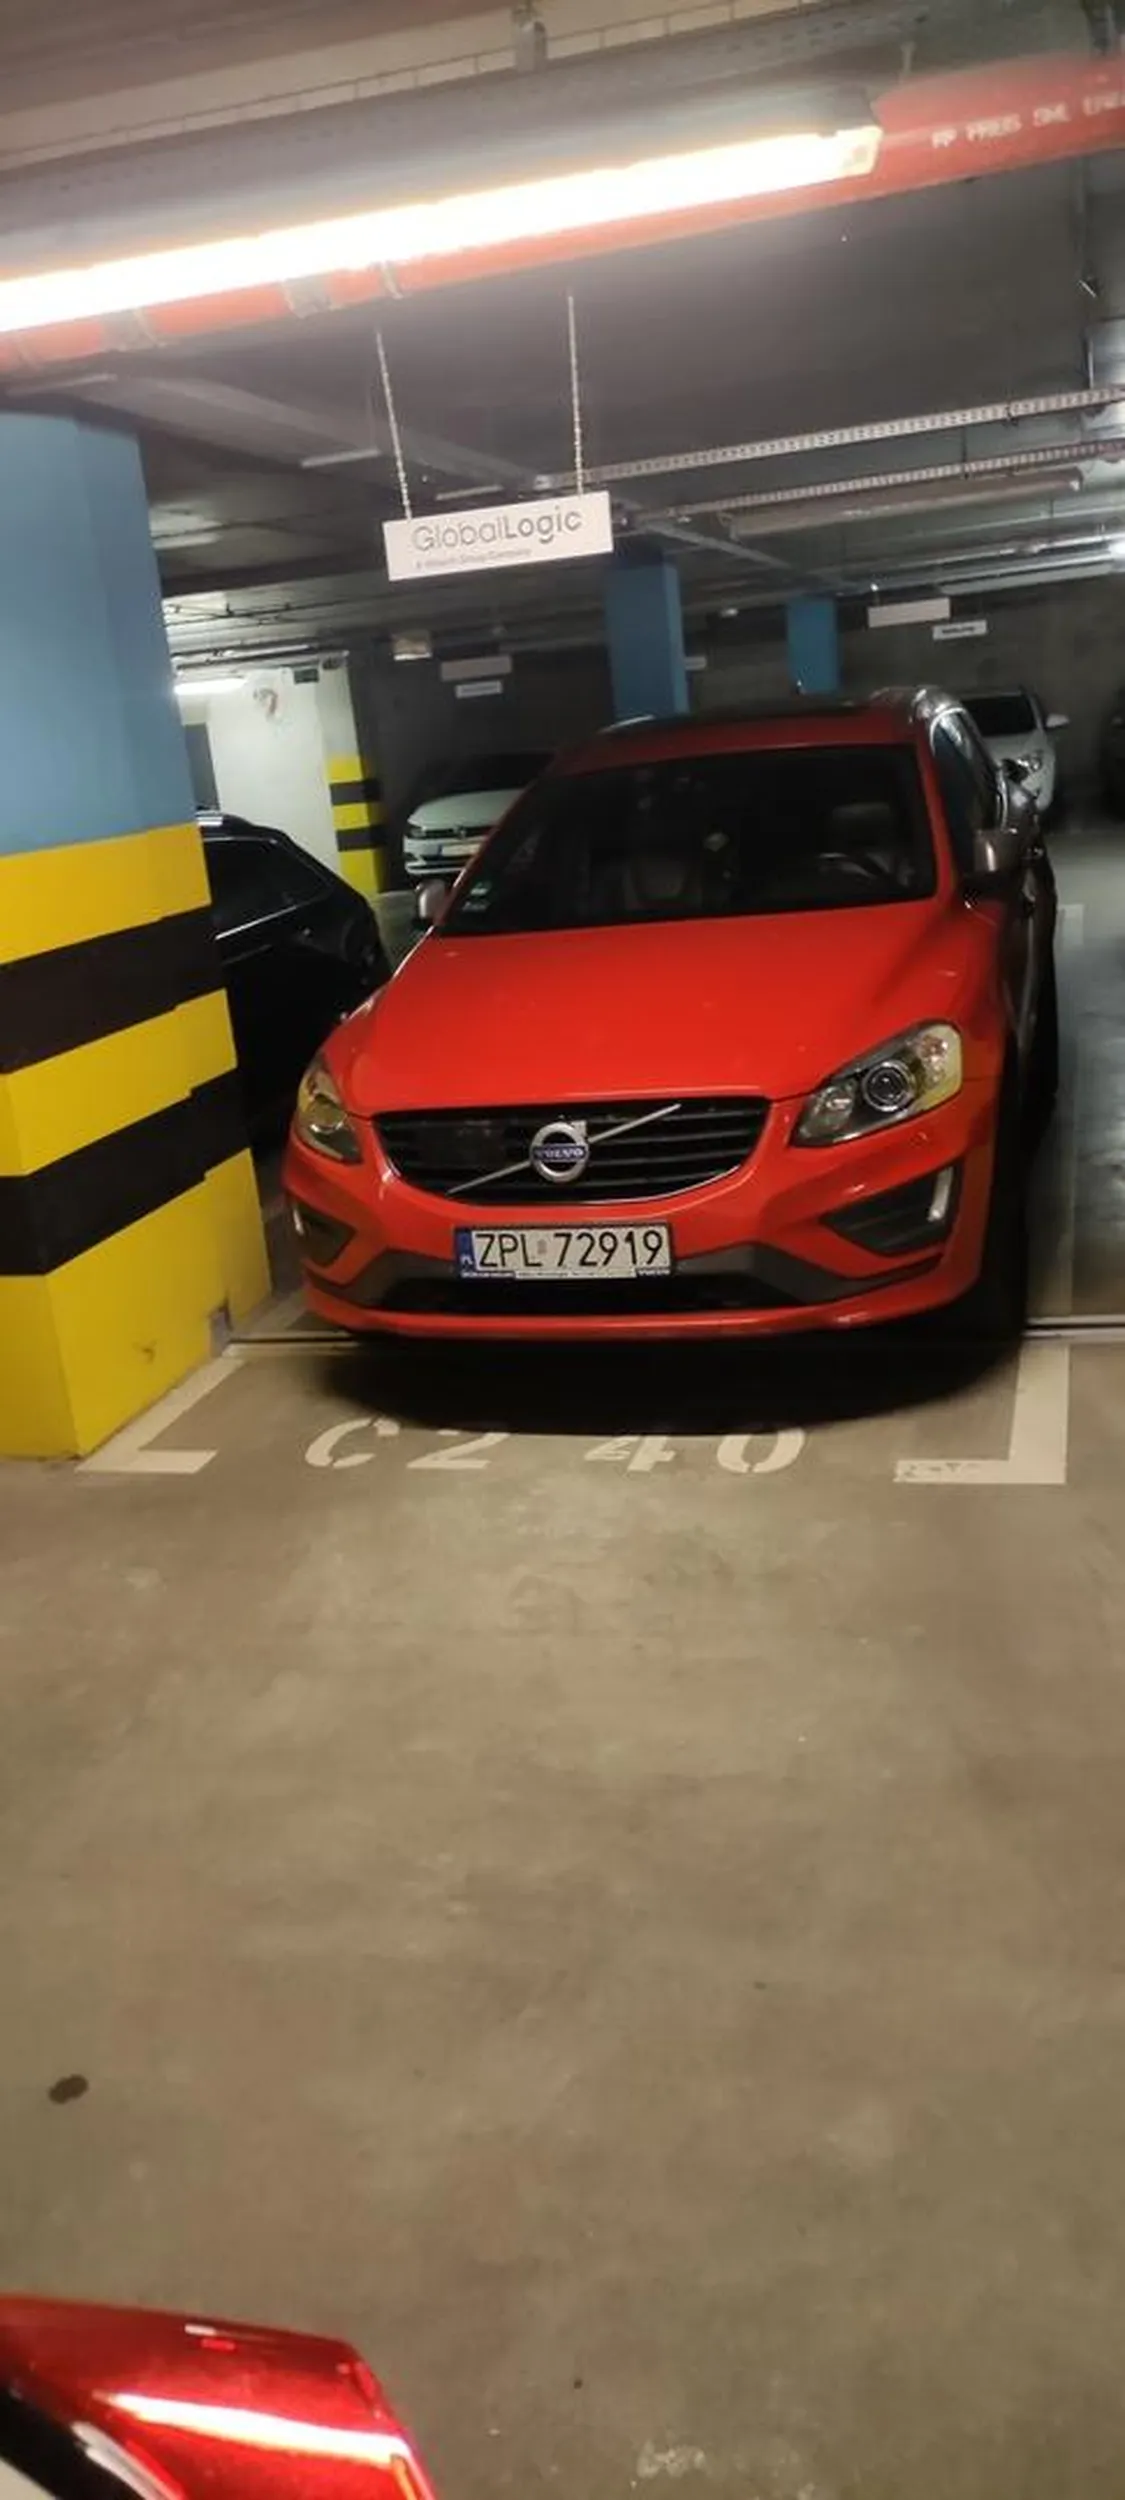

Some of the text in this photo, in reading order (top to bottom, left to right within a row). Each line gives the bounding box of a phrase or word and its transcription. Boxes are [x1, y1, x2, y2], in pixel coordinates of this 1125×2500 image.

[412, 505, 583, 552] GlobalLogic
[534, 1147, 584, 1159] VOLVO
[475, 1229, 664, 1268] ZPL 72919
